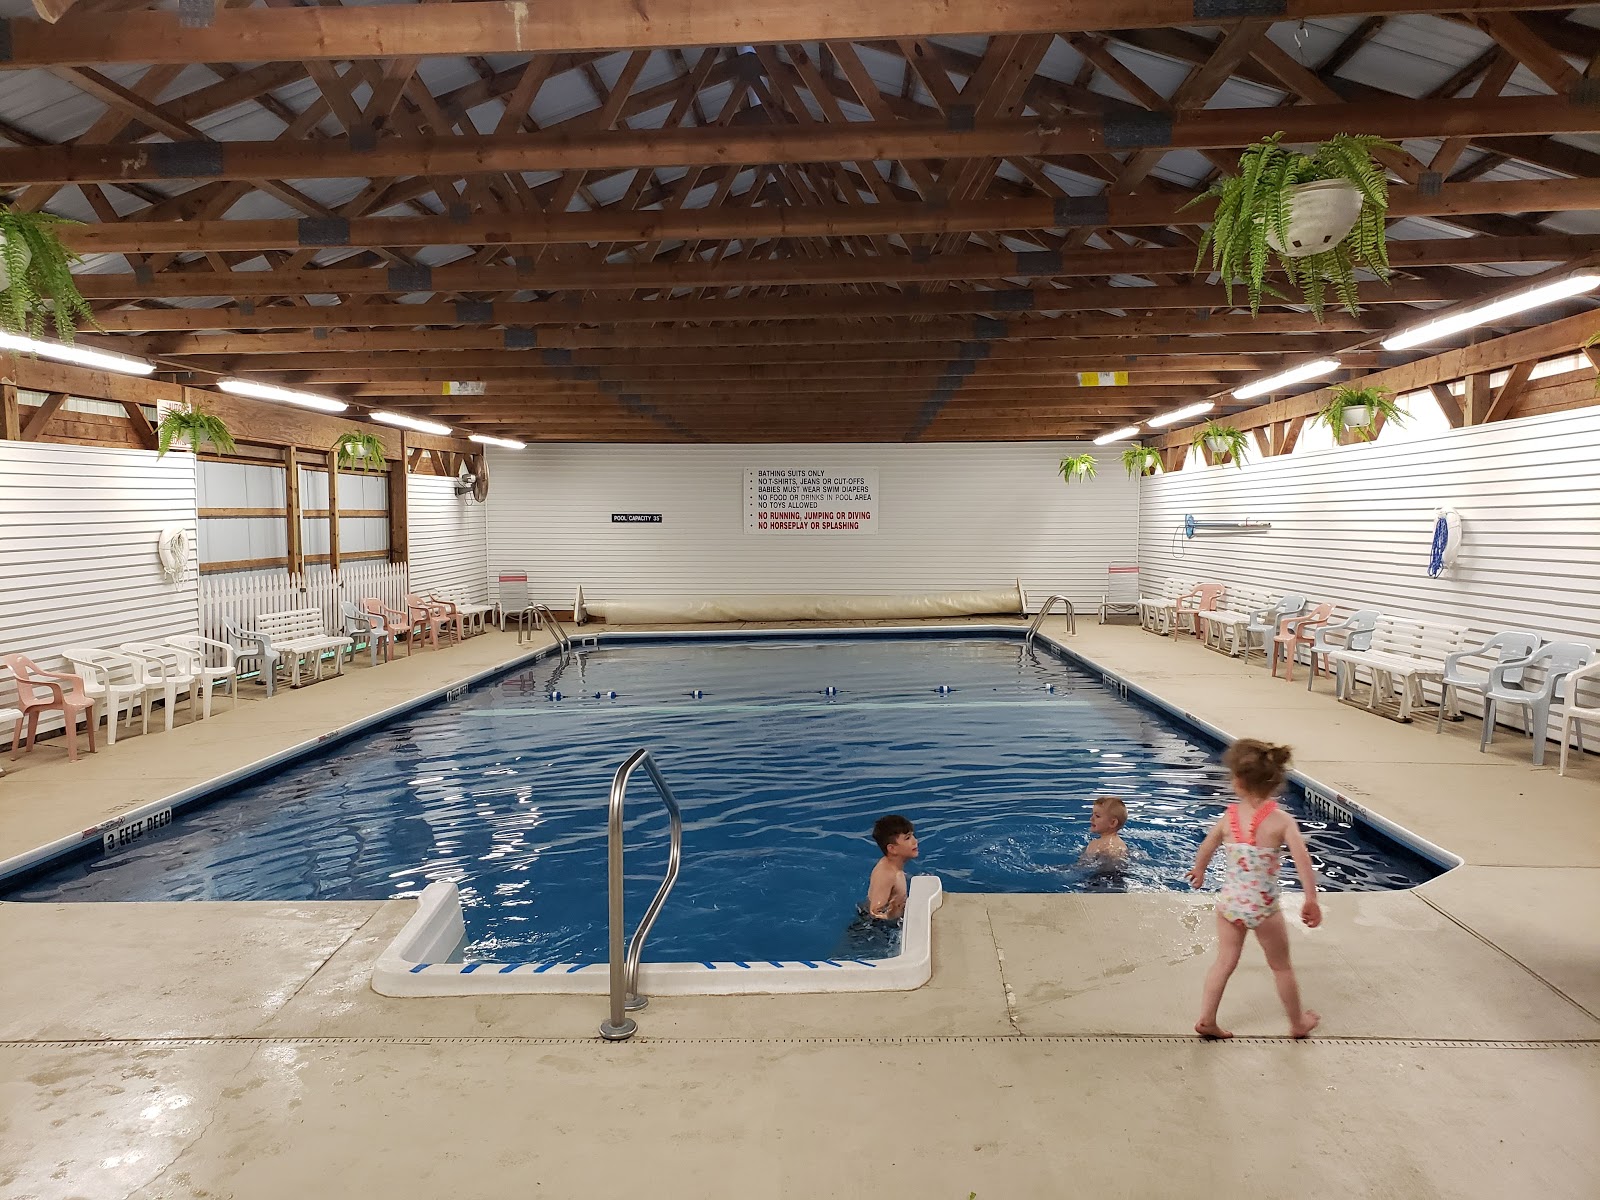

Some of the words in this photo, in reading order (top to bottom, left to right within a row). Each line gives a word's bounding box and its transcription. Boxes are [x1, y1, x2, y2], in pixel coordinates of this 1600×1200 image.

[768, 478, 798, 486] T-SHIRTS,
[758, 511, 768, 520] NO
[770, 511, 802, 521] RUNNING,
[804, 511, 834, 520] JUMPING
[836, 511, 846, 520] OR
[848, 511, 871, 520] DIVING
[758, 522, 768, 530] NO
[770, 522, 809, 530] HORSEPLAY
[810, 522, 820, 530] OR
[822, 522, 859, 530] SPLASHING
